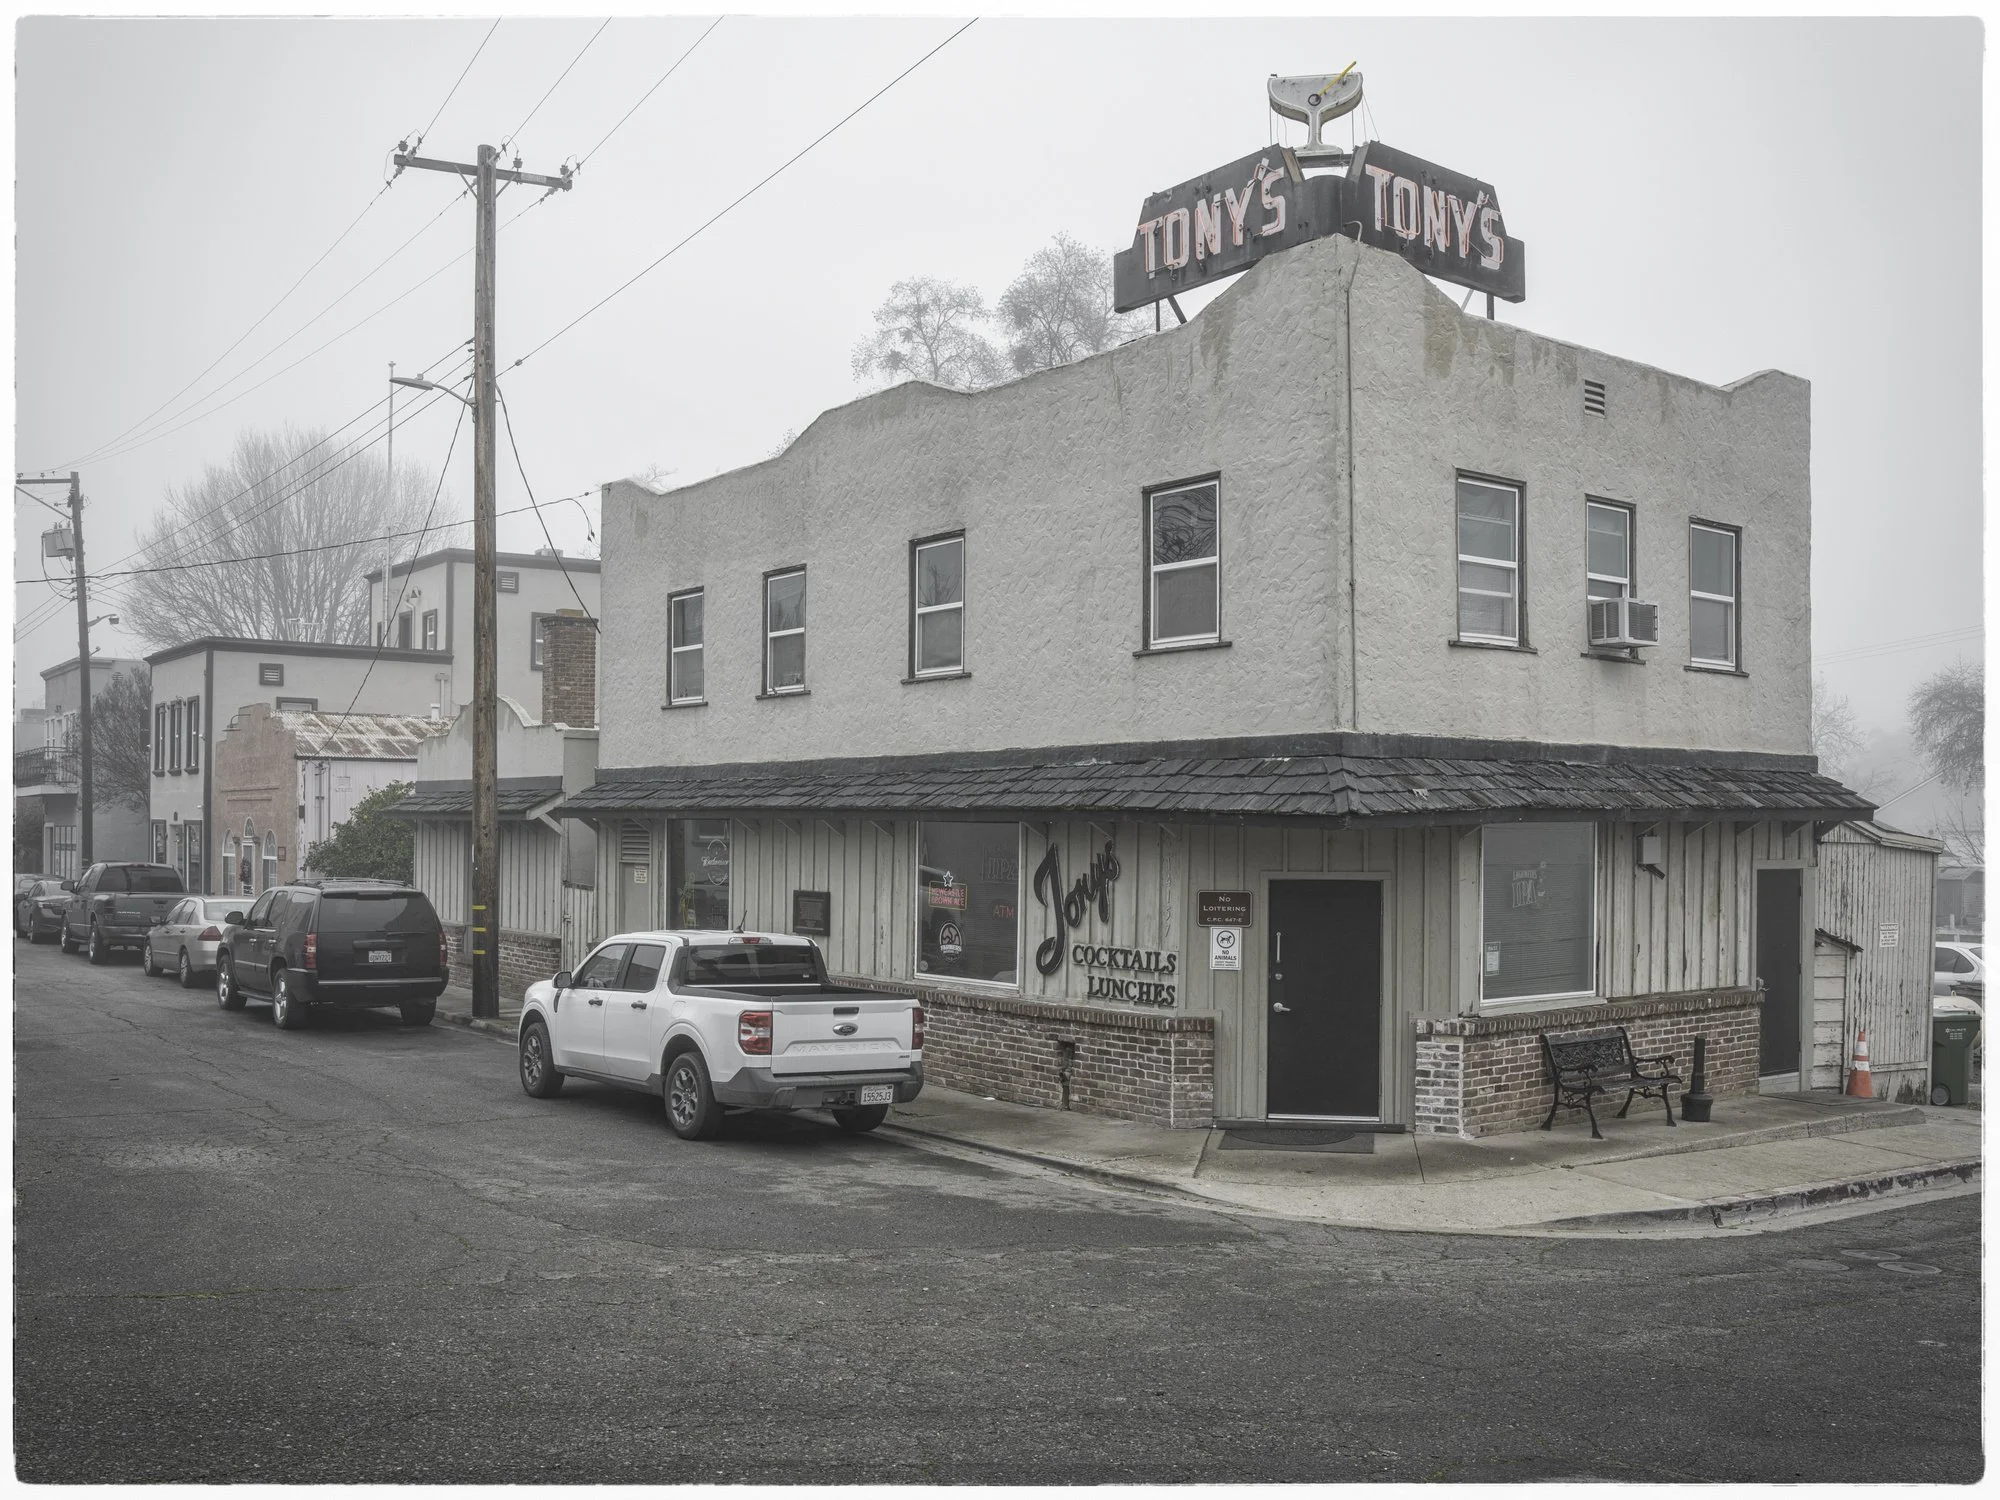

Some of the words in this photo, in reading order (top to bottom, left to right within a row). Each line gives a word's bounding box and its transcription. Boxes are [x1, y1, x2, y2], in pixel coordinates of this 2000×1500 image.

[1138, 158, 1286, 279] TONY'S
[1365, 164, 1504, 270] TONY'S
[993, 905, 1014, 919] ATM
[1072, 944, 1177, 974] COCKTAILS
[1087, 976, 1176, 1006] LUNCHES
